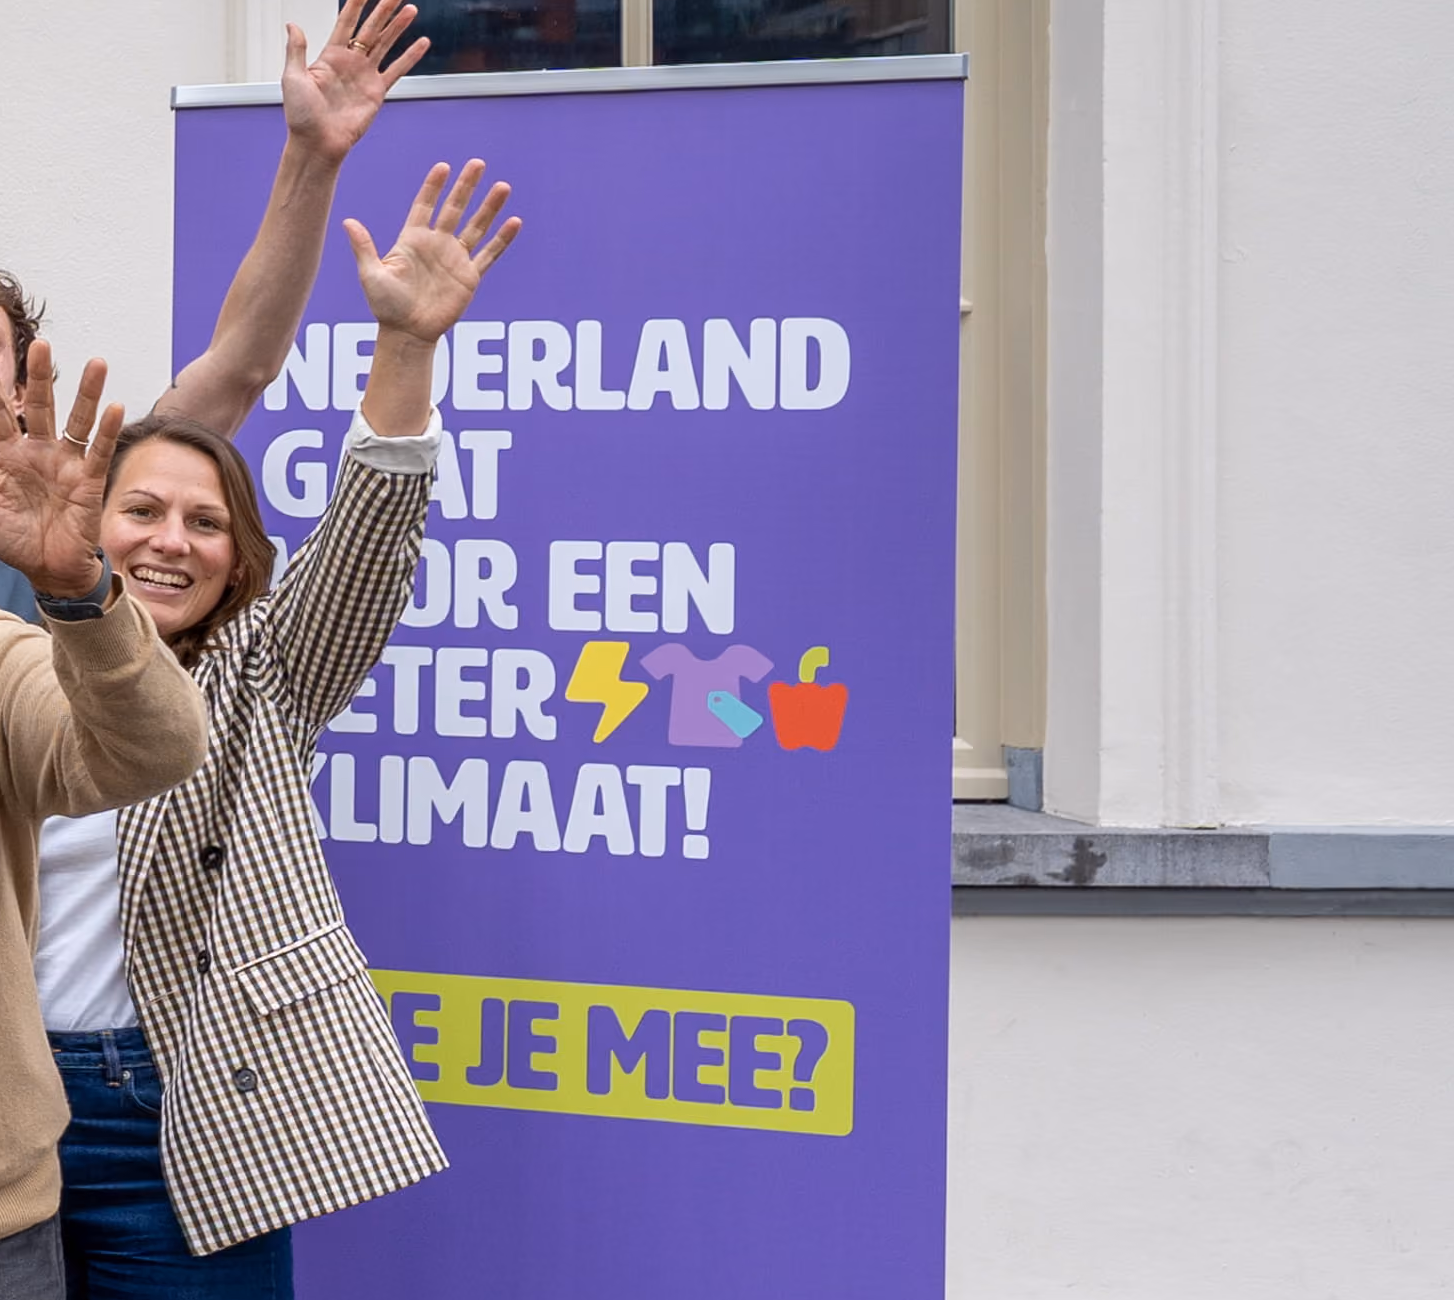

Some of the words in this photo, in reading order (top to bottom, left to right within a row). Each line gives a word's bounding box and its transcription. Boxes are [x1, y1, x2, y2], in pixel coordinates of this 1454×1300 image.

[548, 540, 735, 634] EEN
[466, 997, 560, 1091] JE
[586, 1002, 829, 1112] MEE?
